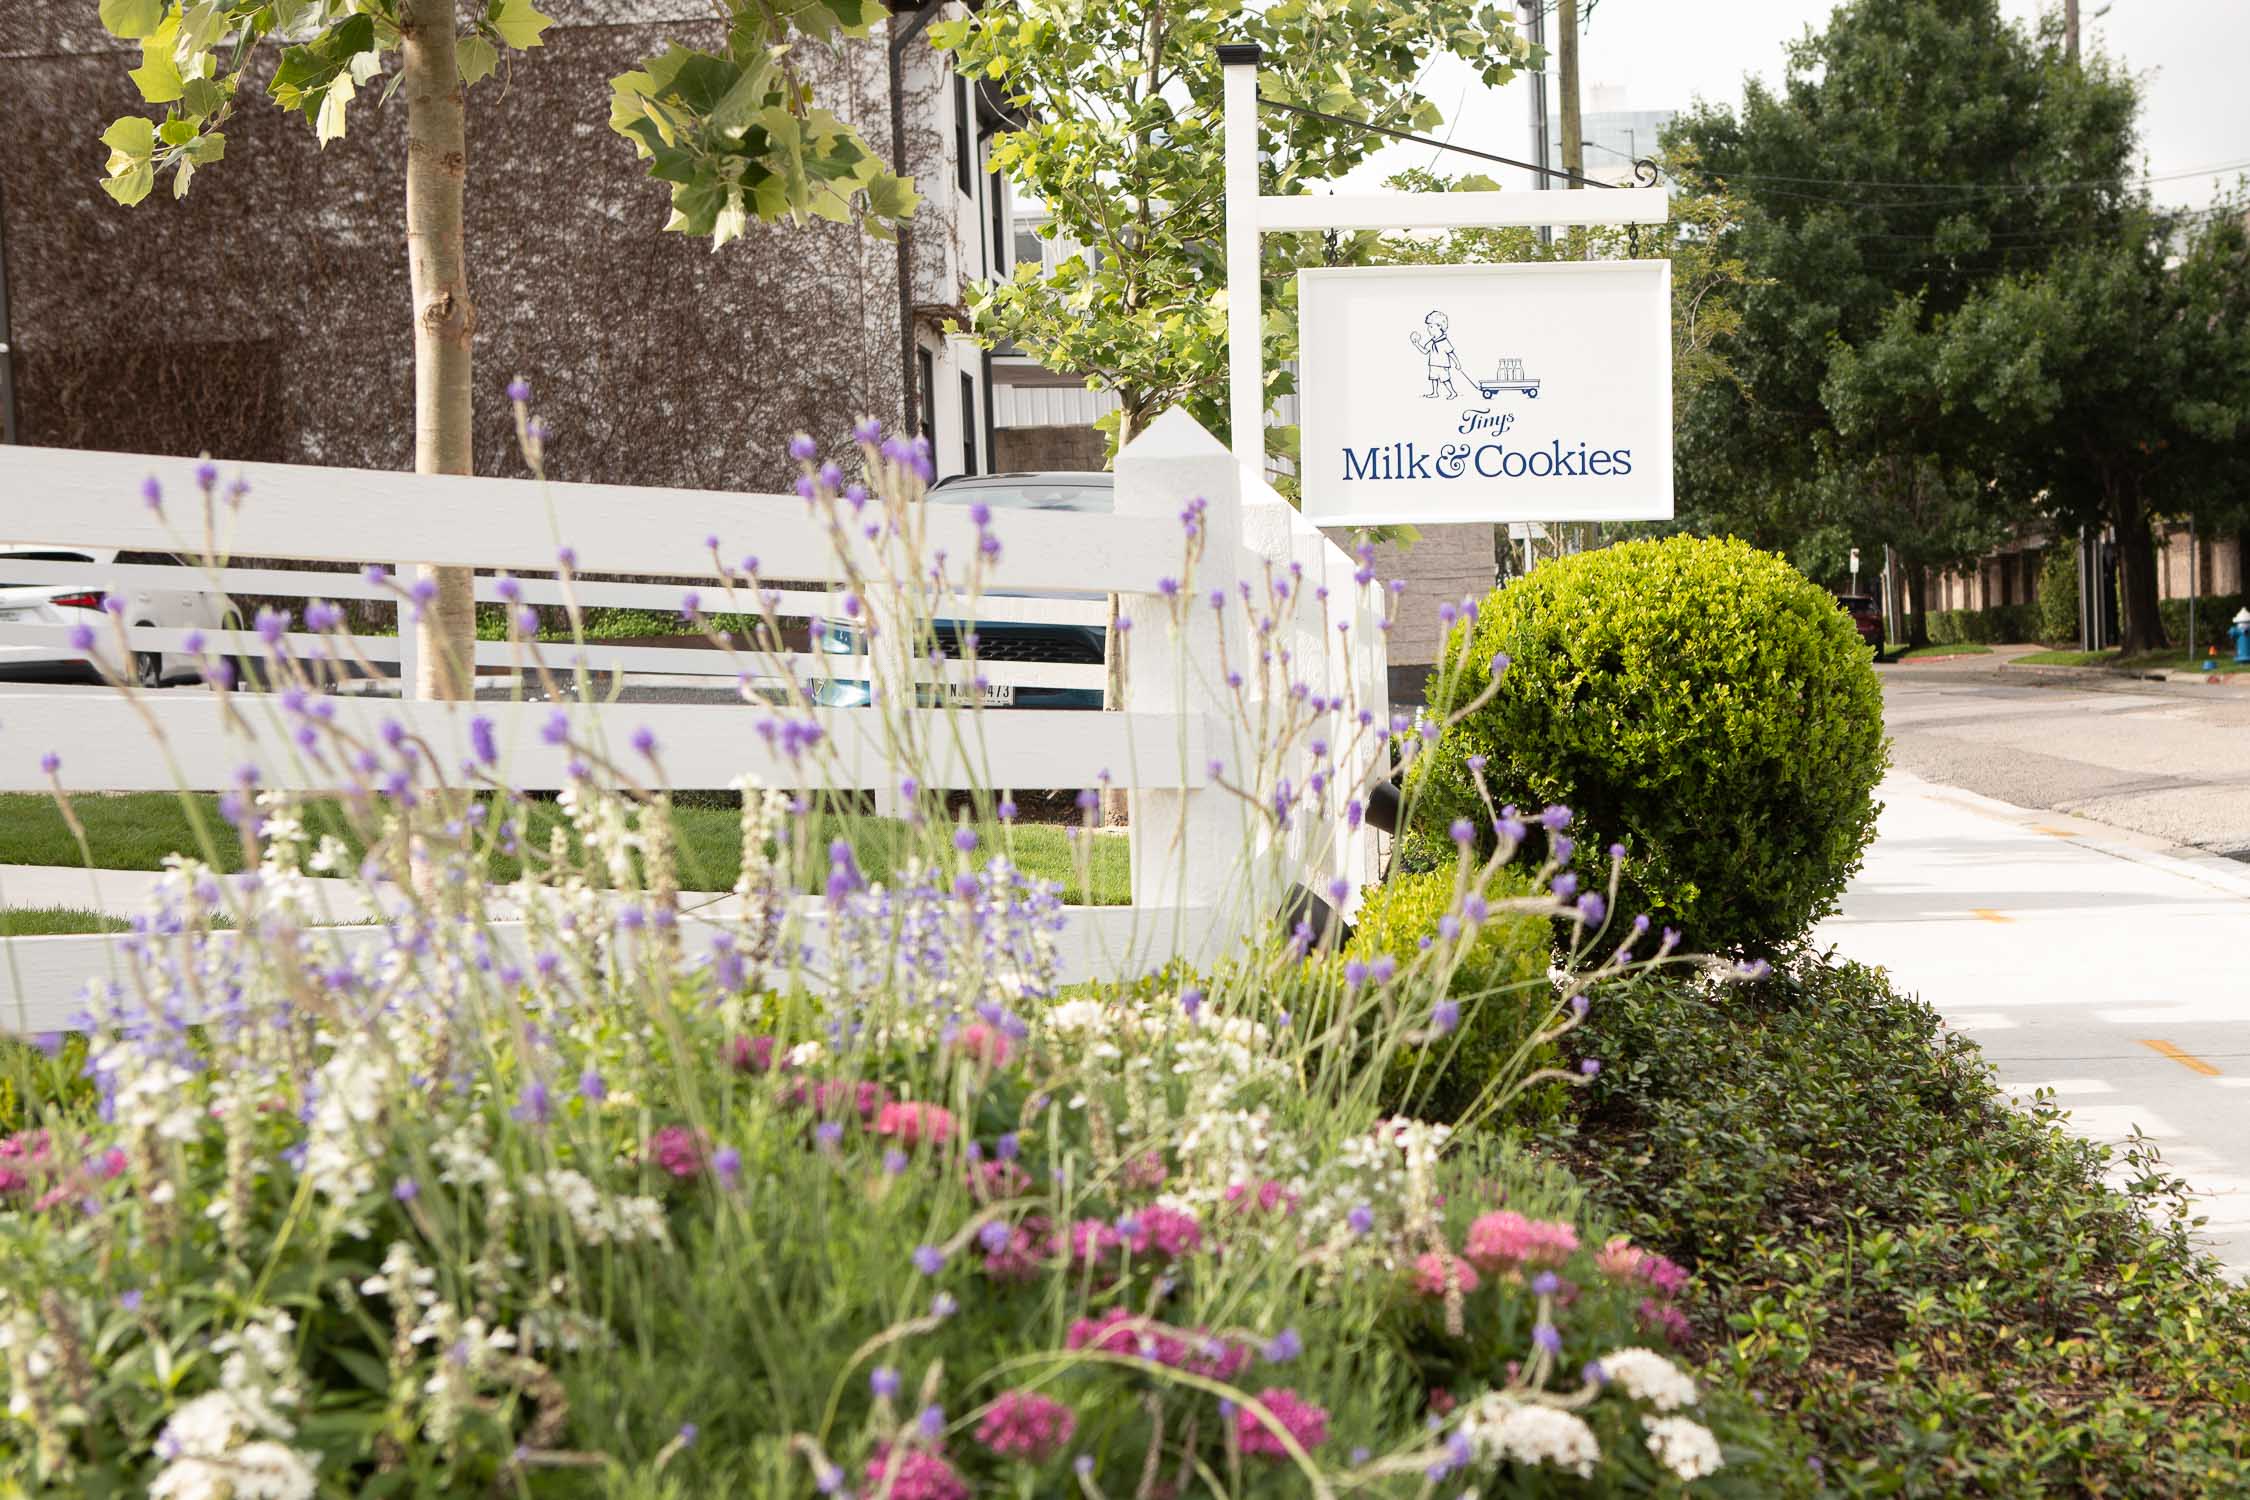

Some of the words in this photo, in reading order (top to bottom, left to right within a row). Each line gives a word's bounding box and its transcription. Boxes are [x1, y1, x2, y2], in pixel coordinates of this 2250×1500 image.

[1342, 443, 1431, 480] Milk
[1435, 444, 1471, 478] &
[1475, 440, 1632, 478] Cookies
